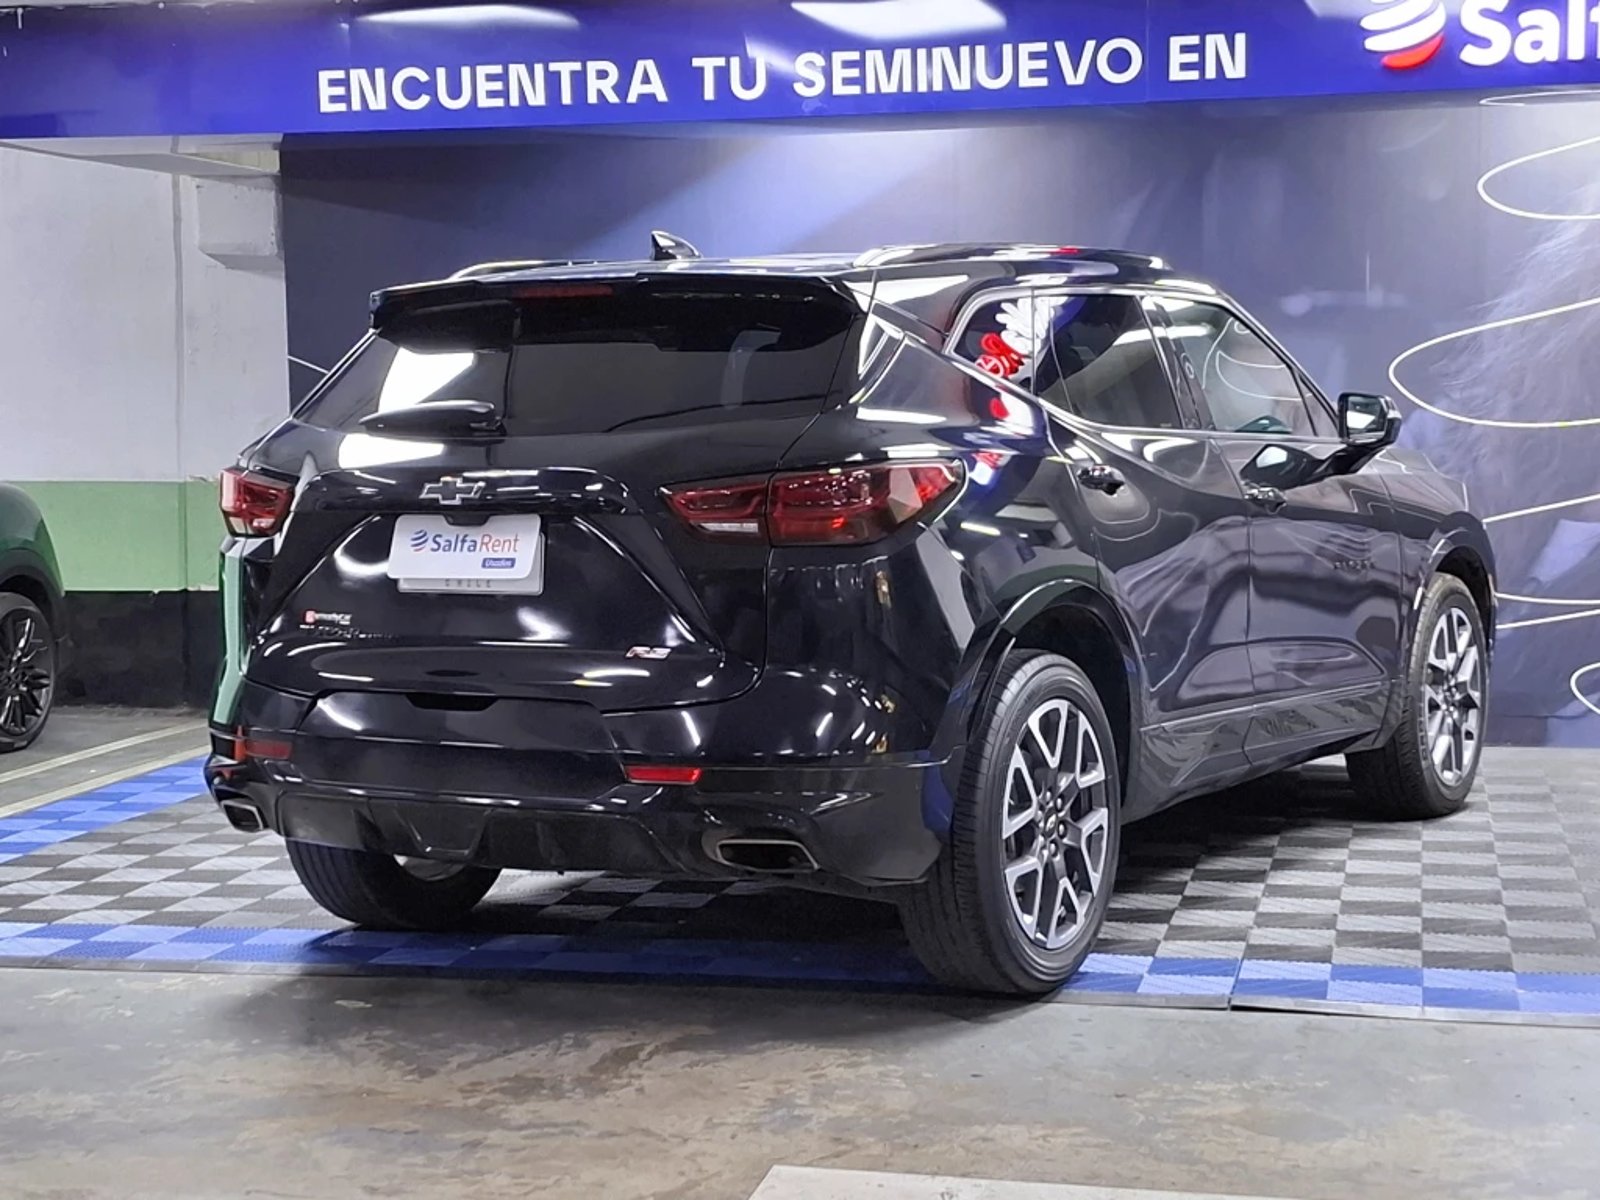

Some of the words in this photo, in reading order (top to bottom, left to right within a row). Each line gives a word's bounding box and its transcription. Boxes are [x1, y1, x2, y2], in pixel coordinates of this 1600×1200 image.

[1458, 0, 1600, 67] Sal
[318, 58, 669, 113] ENCUENTRA
[691, 55, 768, 101] TU
[792, 37, 1144, 98] SEMINUEVO
[1168, 32, 1247, 82] EN
[430, 533, 520, 553] SalfaRent
